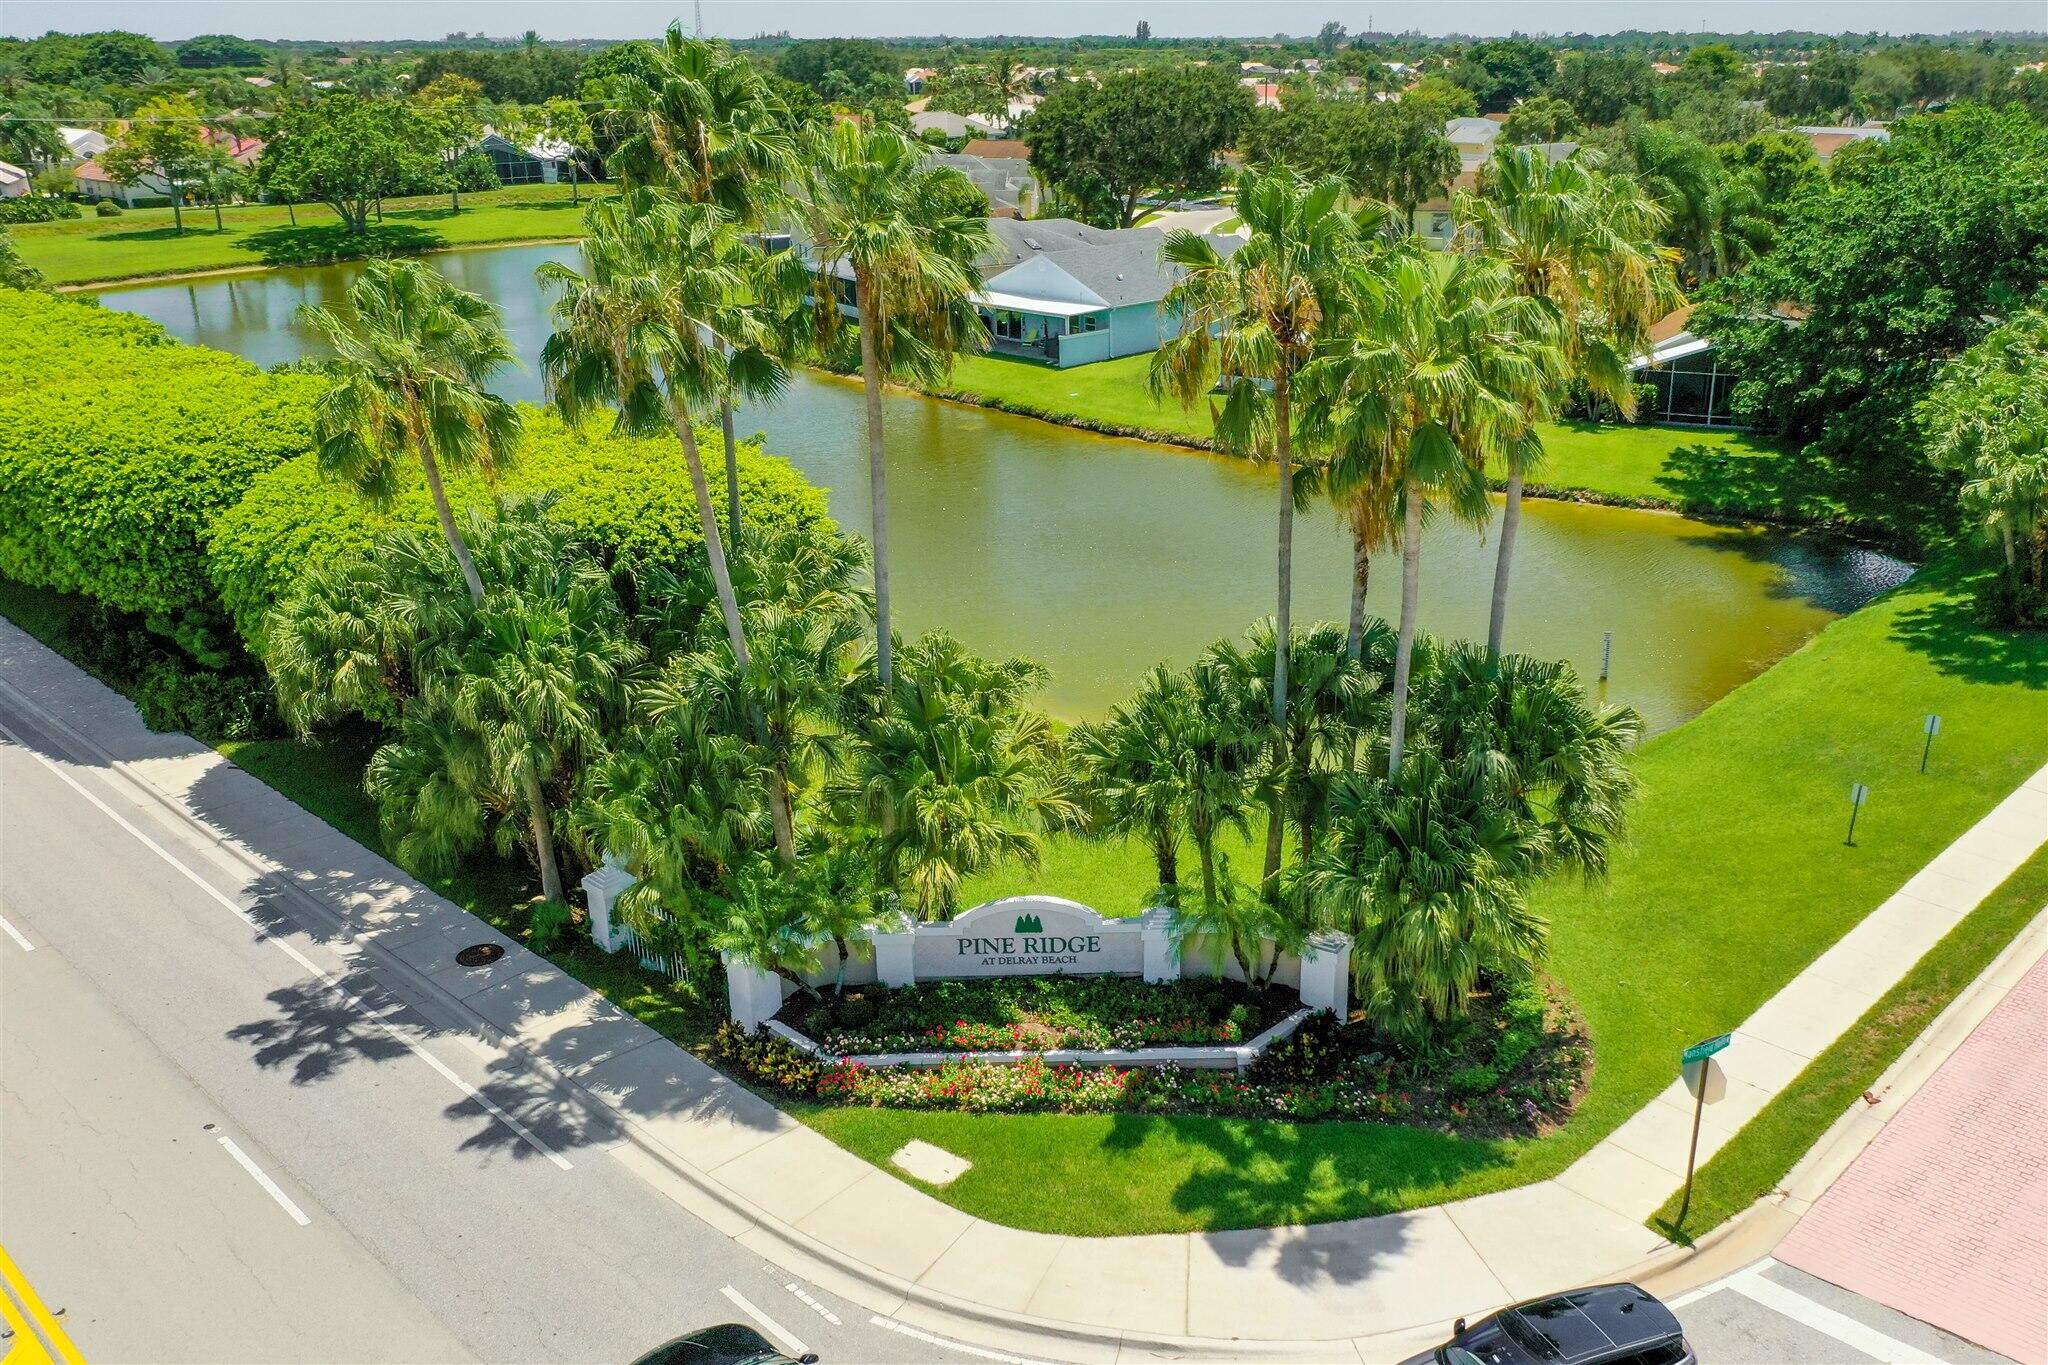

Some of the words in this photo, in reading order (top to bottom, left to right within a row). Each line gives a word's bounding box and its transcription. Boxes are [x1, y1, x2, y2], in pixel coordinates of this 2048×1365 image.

[956, 937, 1015, 955] PINE
[1022, 936, 1101, 954] RIDGE
[981, 957, 996, 966] AT
[998, 956, 1038, 965] DELRAY
[1041, 955, 1077, 964] BEACH
